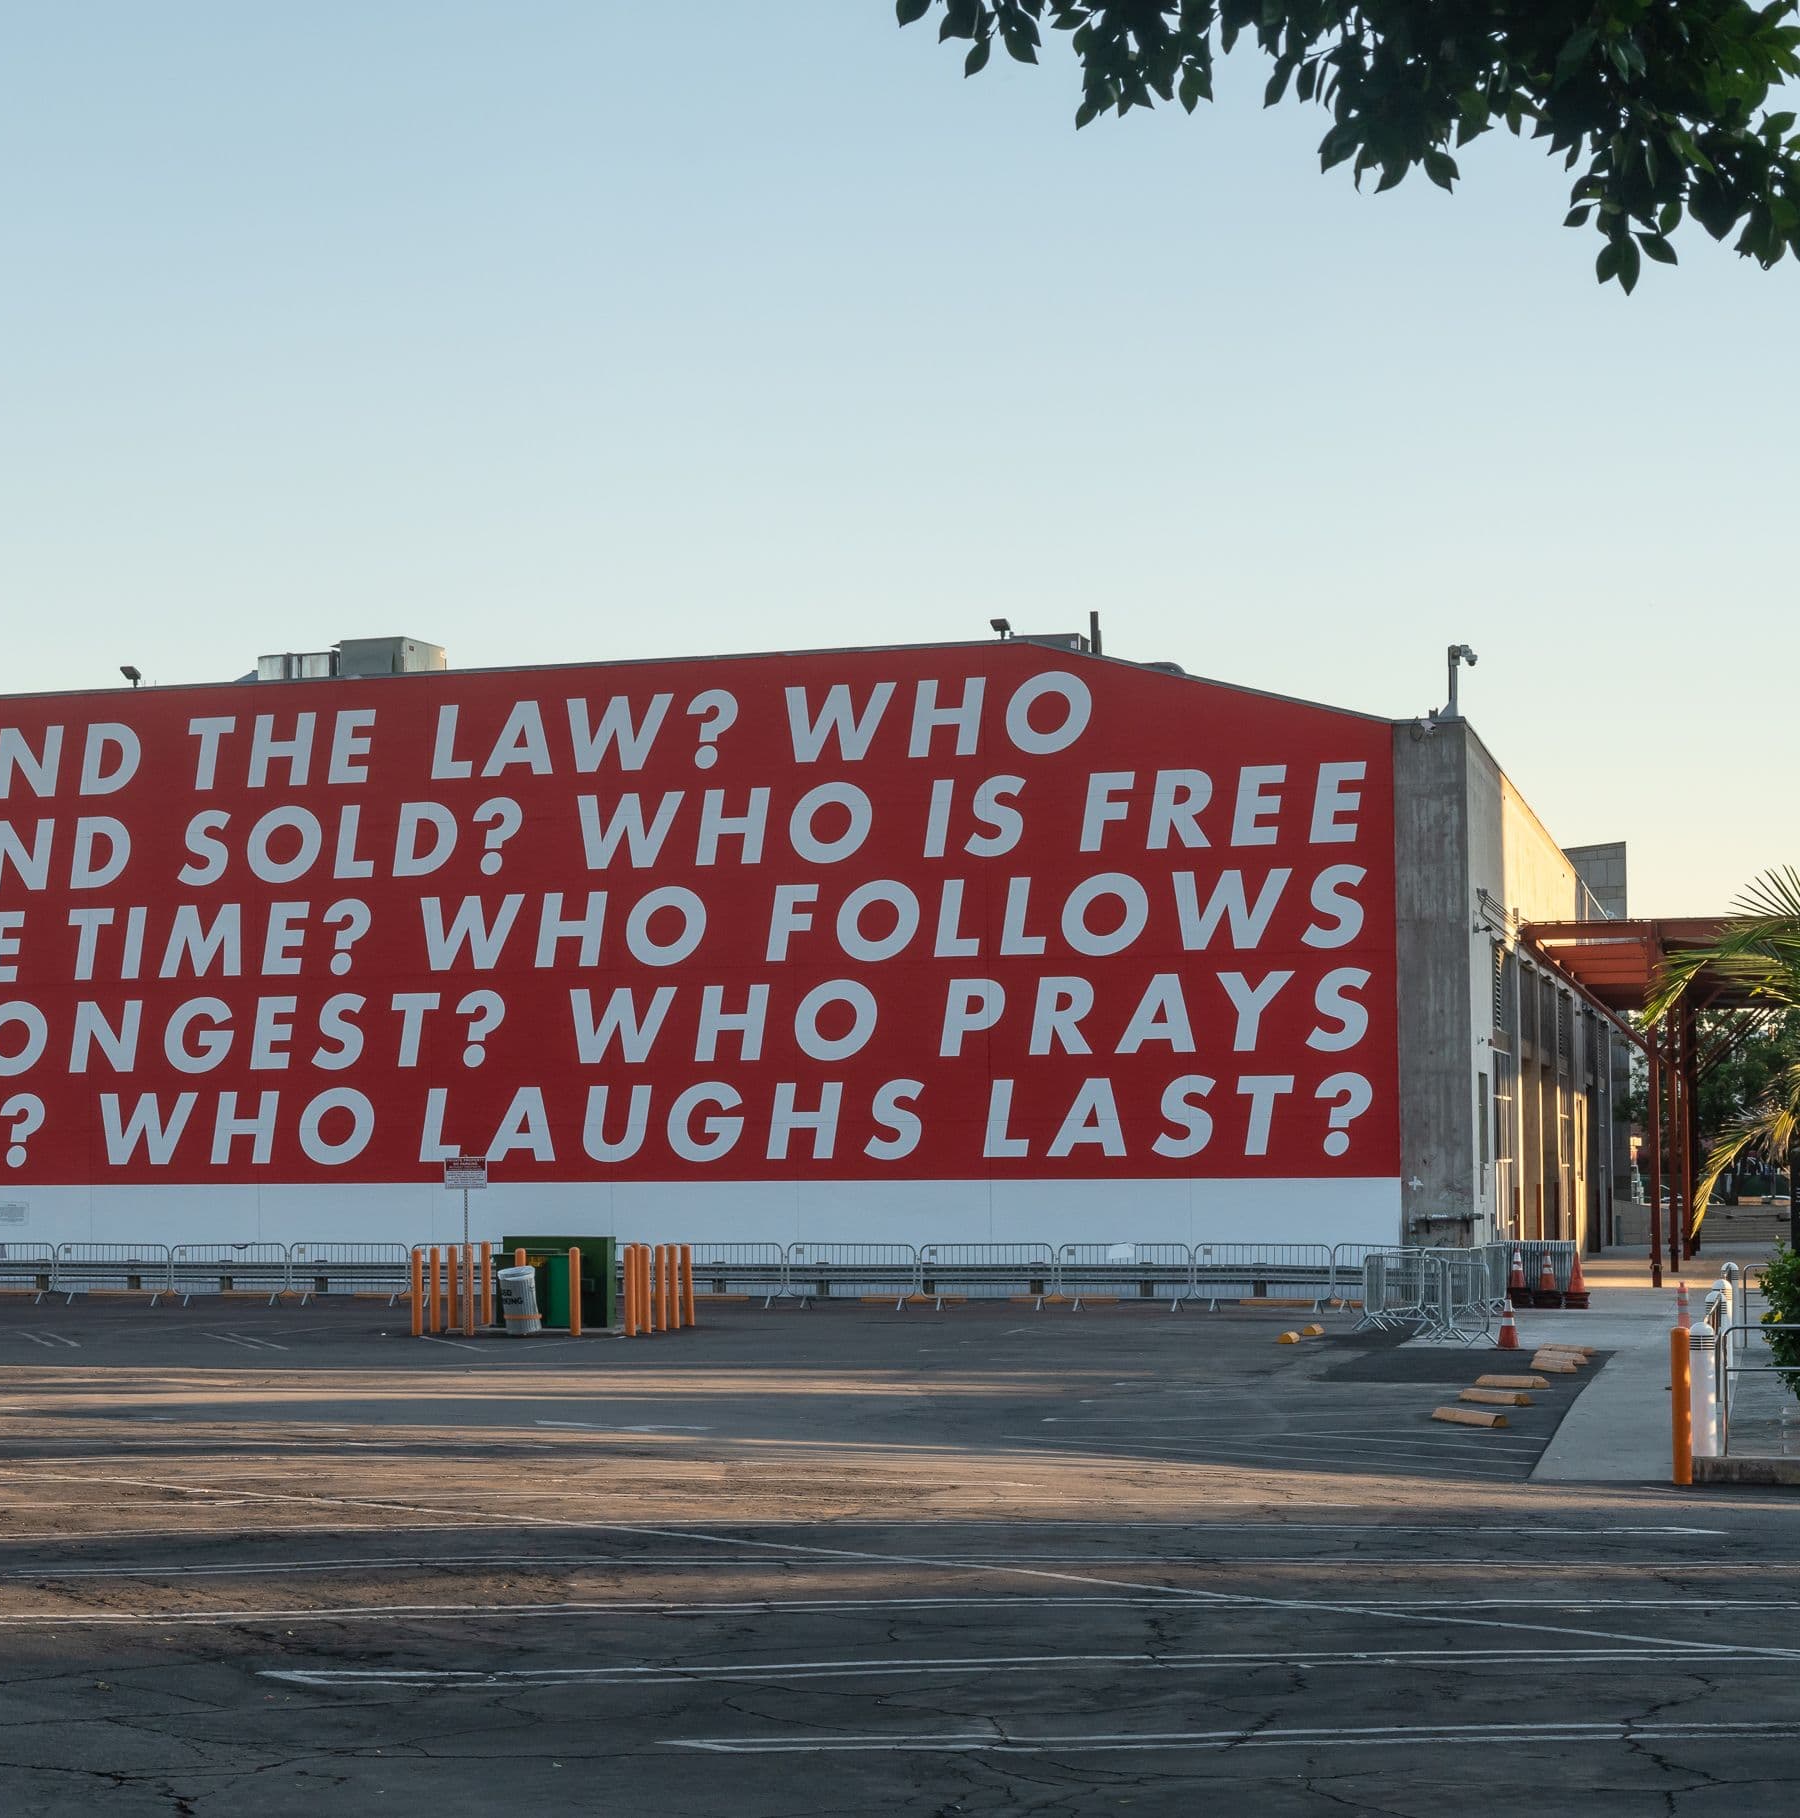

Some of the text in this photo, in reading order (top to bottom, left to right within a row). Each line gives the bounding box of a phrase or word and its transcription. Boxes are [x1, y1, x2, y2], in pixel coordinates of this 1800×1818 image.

[189, 710, 376, 790] THE
[431, 689, 738, 779] LAW?
[785, 671, 1091, 762] WHO
[178, 797, 522, 886] SOLD?
[577, 782, 872, 869] WHO
[924, 775, 1026, 857] IS
[1080, 762, 1366, 851] FREE
[68, 899, 371, 980] TIME?
[421, 886, 706, 970] WHO
[766, 864, 1367, 961] FOLLOWS
[570, 980, 877, 1063] WHO
[940, 968, 1371, 1056] PRAYS
[100, 1087, 374, 1165] WHO
[418, 1079, 924, 1163] LAUGHS
[983, 1072, 1372, 1158] LAST?
